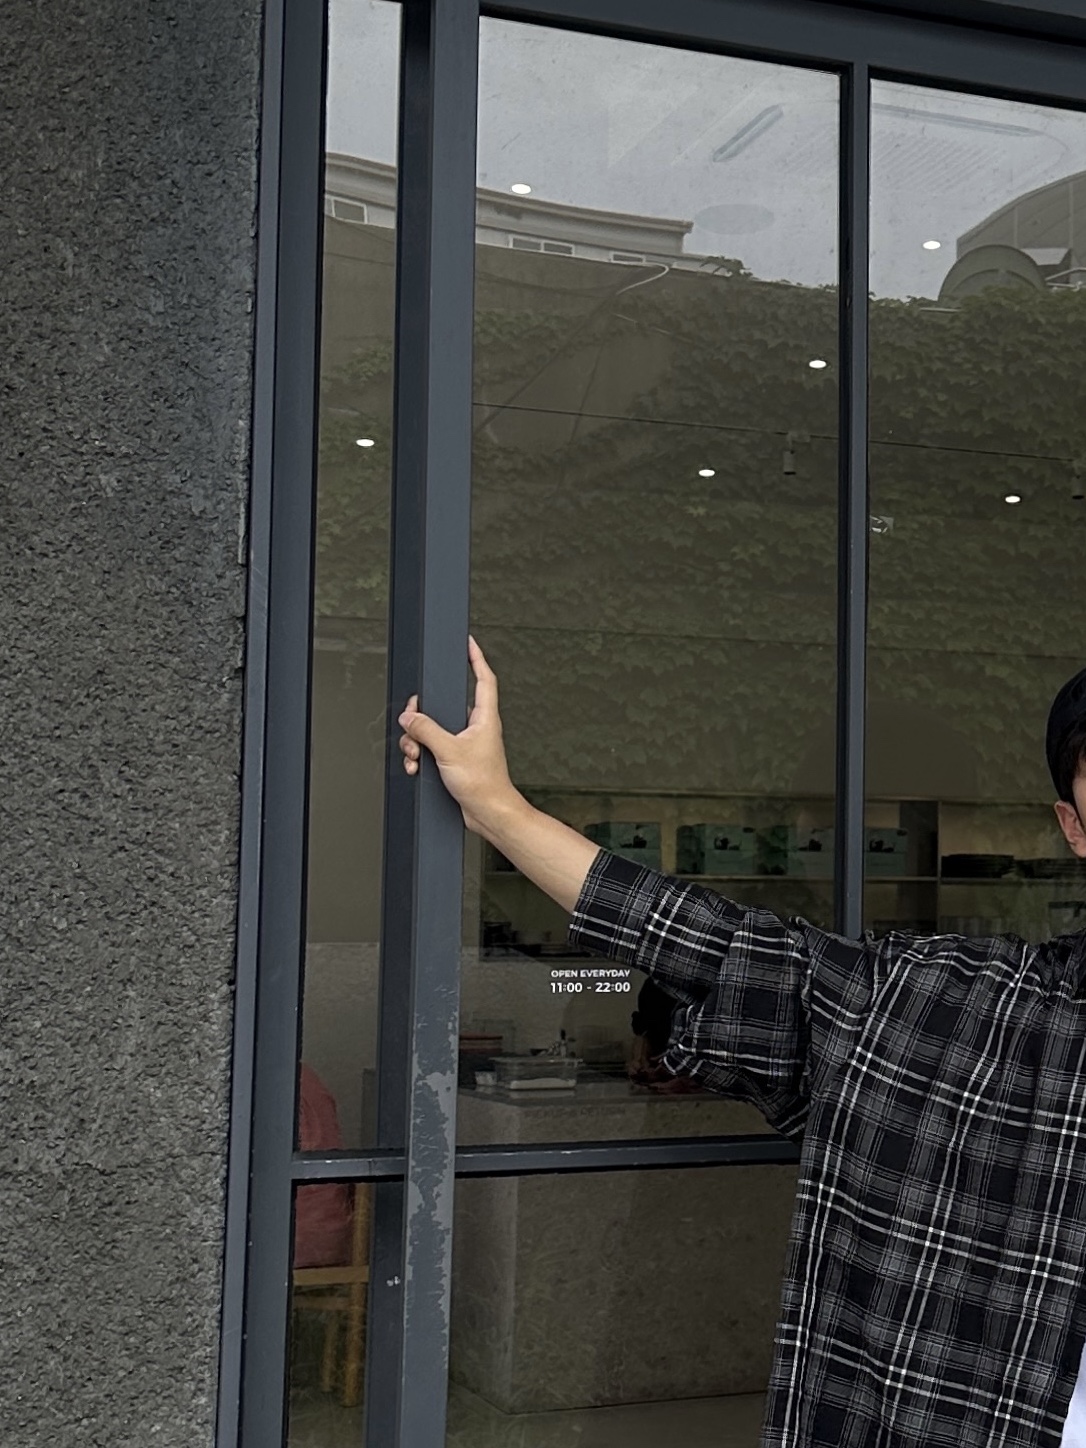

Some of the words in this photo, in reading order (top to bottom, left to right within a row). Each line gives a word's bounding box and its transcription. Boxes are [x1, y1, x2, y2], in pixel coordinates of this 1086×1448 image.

[550, 969, 578, 978] OPEN
[580, 969, 631, 978] EVERYDAY
[550, 982, 583, 993] 11:00
[595, 981, 631, 993] 22:00
